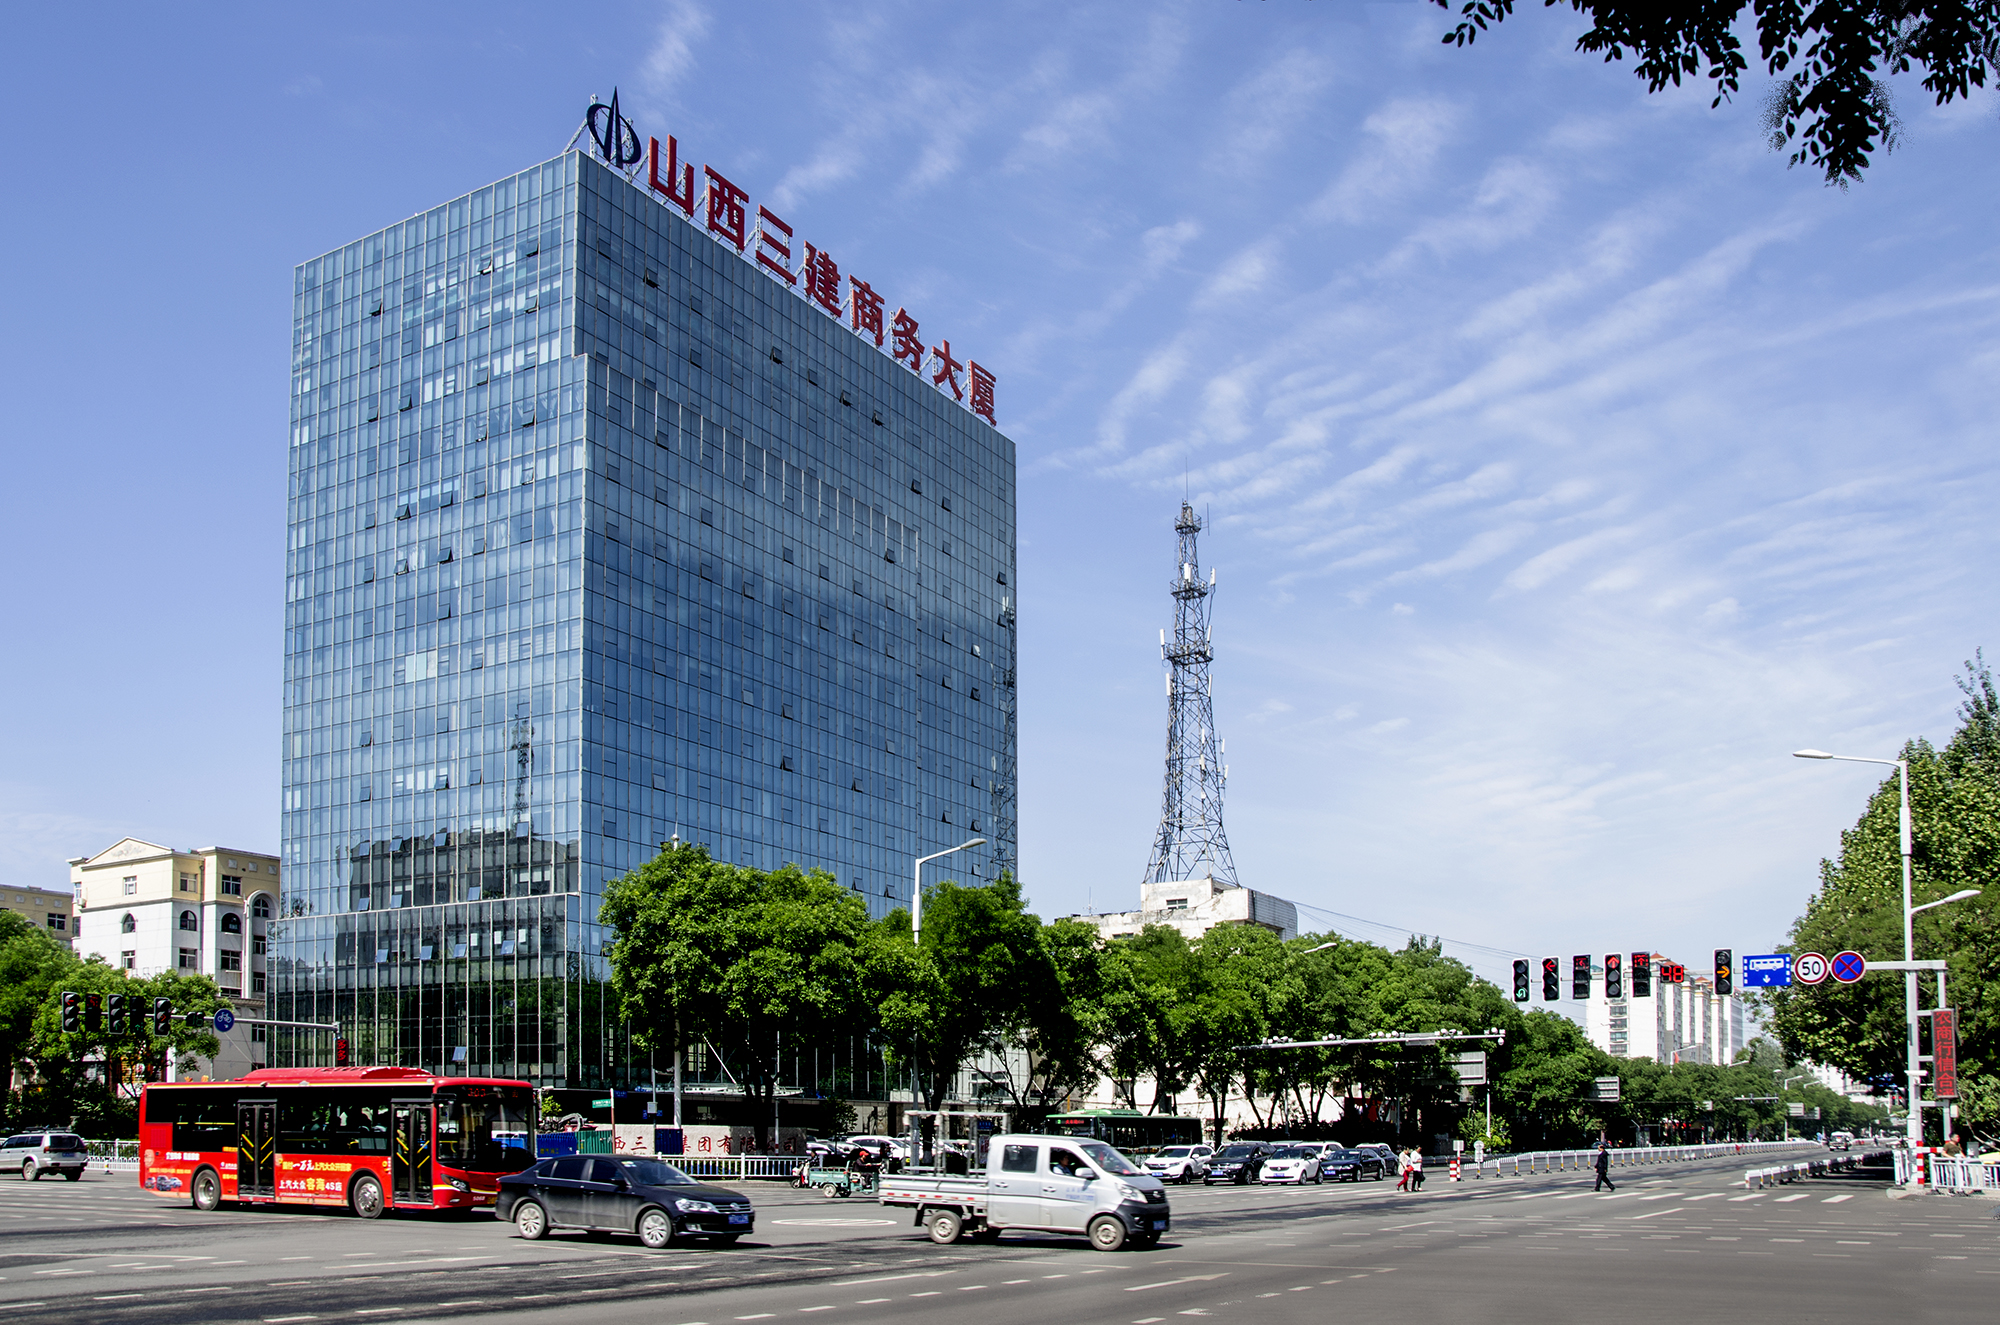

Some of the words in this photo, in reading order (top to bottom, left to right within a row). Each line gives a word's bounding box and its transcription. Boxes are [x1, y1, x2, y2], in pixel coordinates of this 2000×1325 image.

[649, 134, 997, 426] 山西三建商务大厦
[1661, 965, 1684, 983] 48
[1802, 961, 1821, 976] 50
